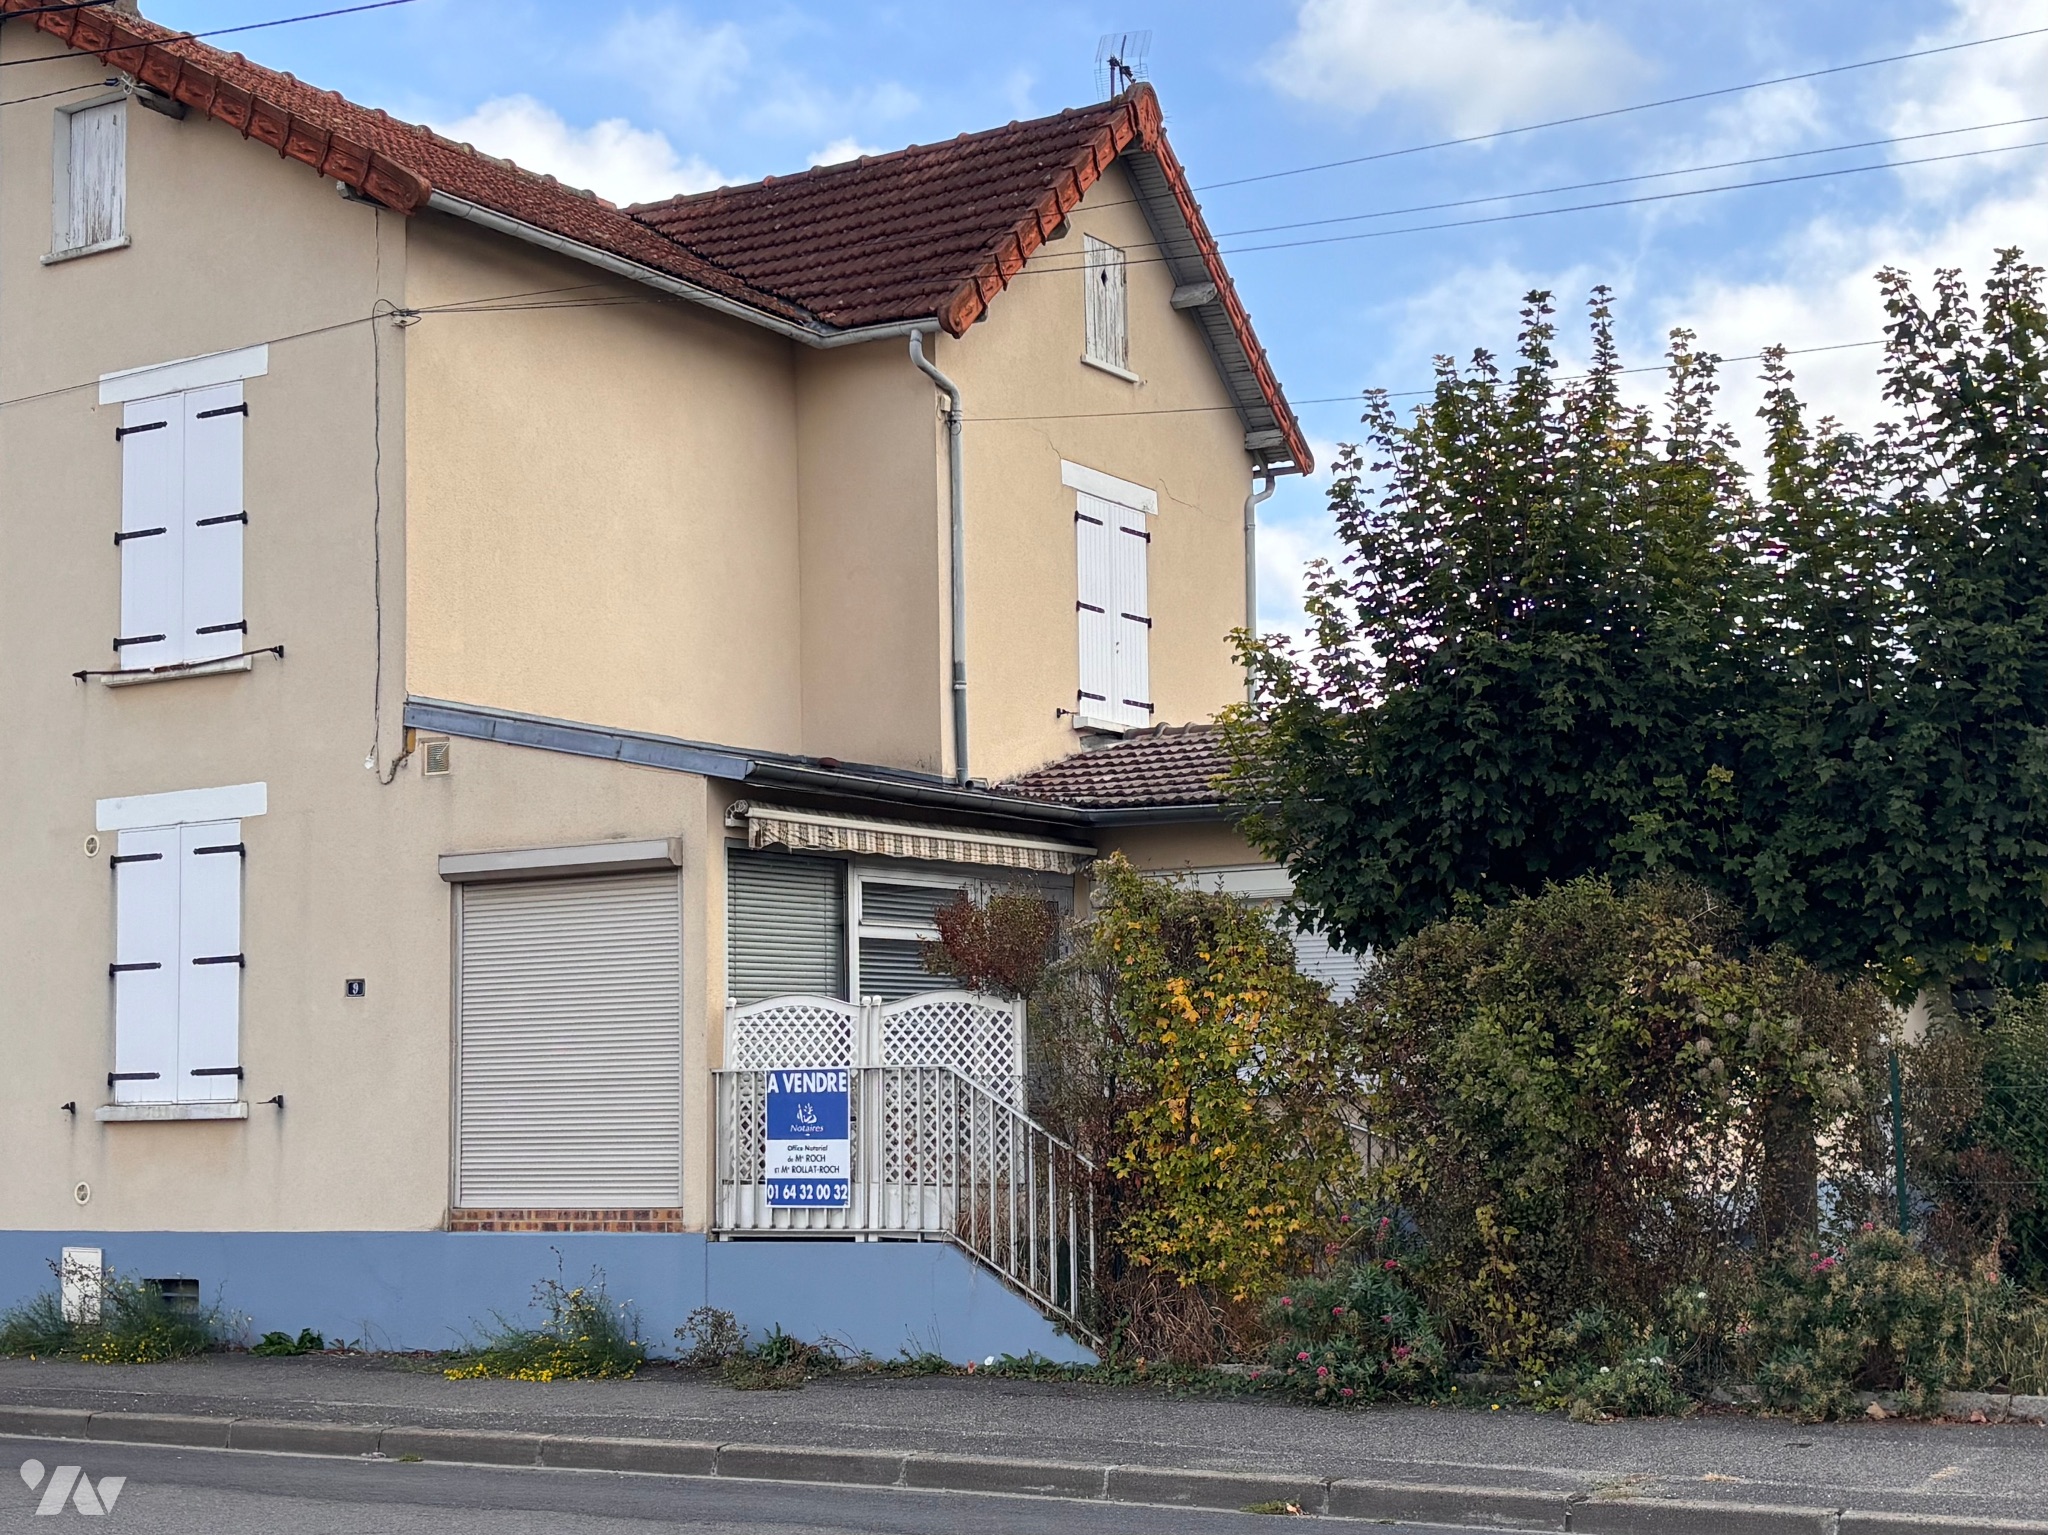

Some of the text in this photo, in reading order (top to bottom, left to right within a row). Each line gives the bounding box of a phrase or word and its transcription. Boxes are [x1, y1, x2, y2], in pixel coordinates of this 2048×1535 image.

[353, 982, 359, 995] 9
[767, 1072, 847, 1093] A VENDRE
[790, 1124, 824, 1132] Notaires
[806, 1154, 826, 1162] ROCH
[792, 1165, 840, 1173] ROLLAT-ROCH
[767, 1184, 848, 1200] 01 64 32 00 32
